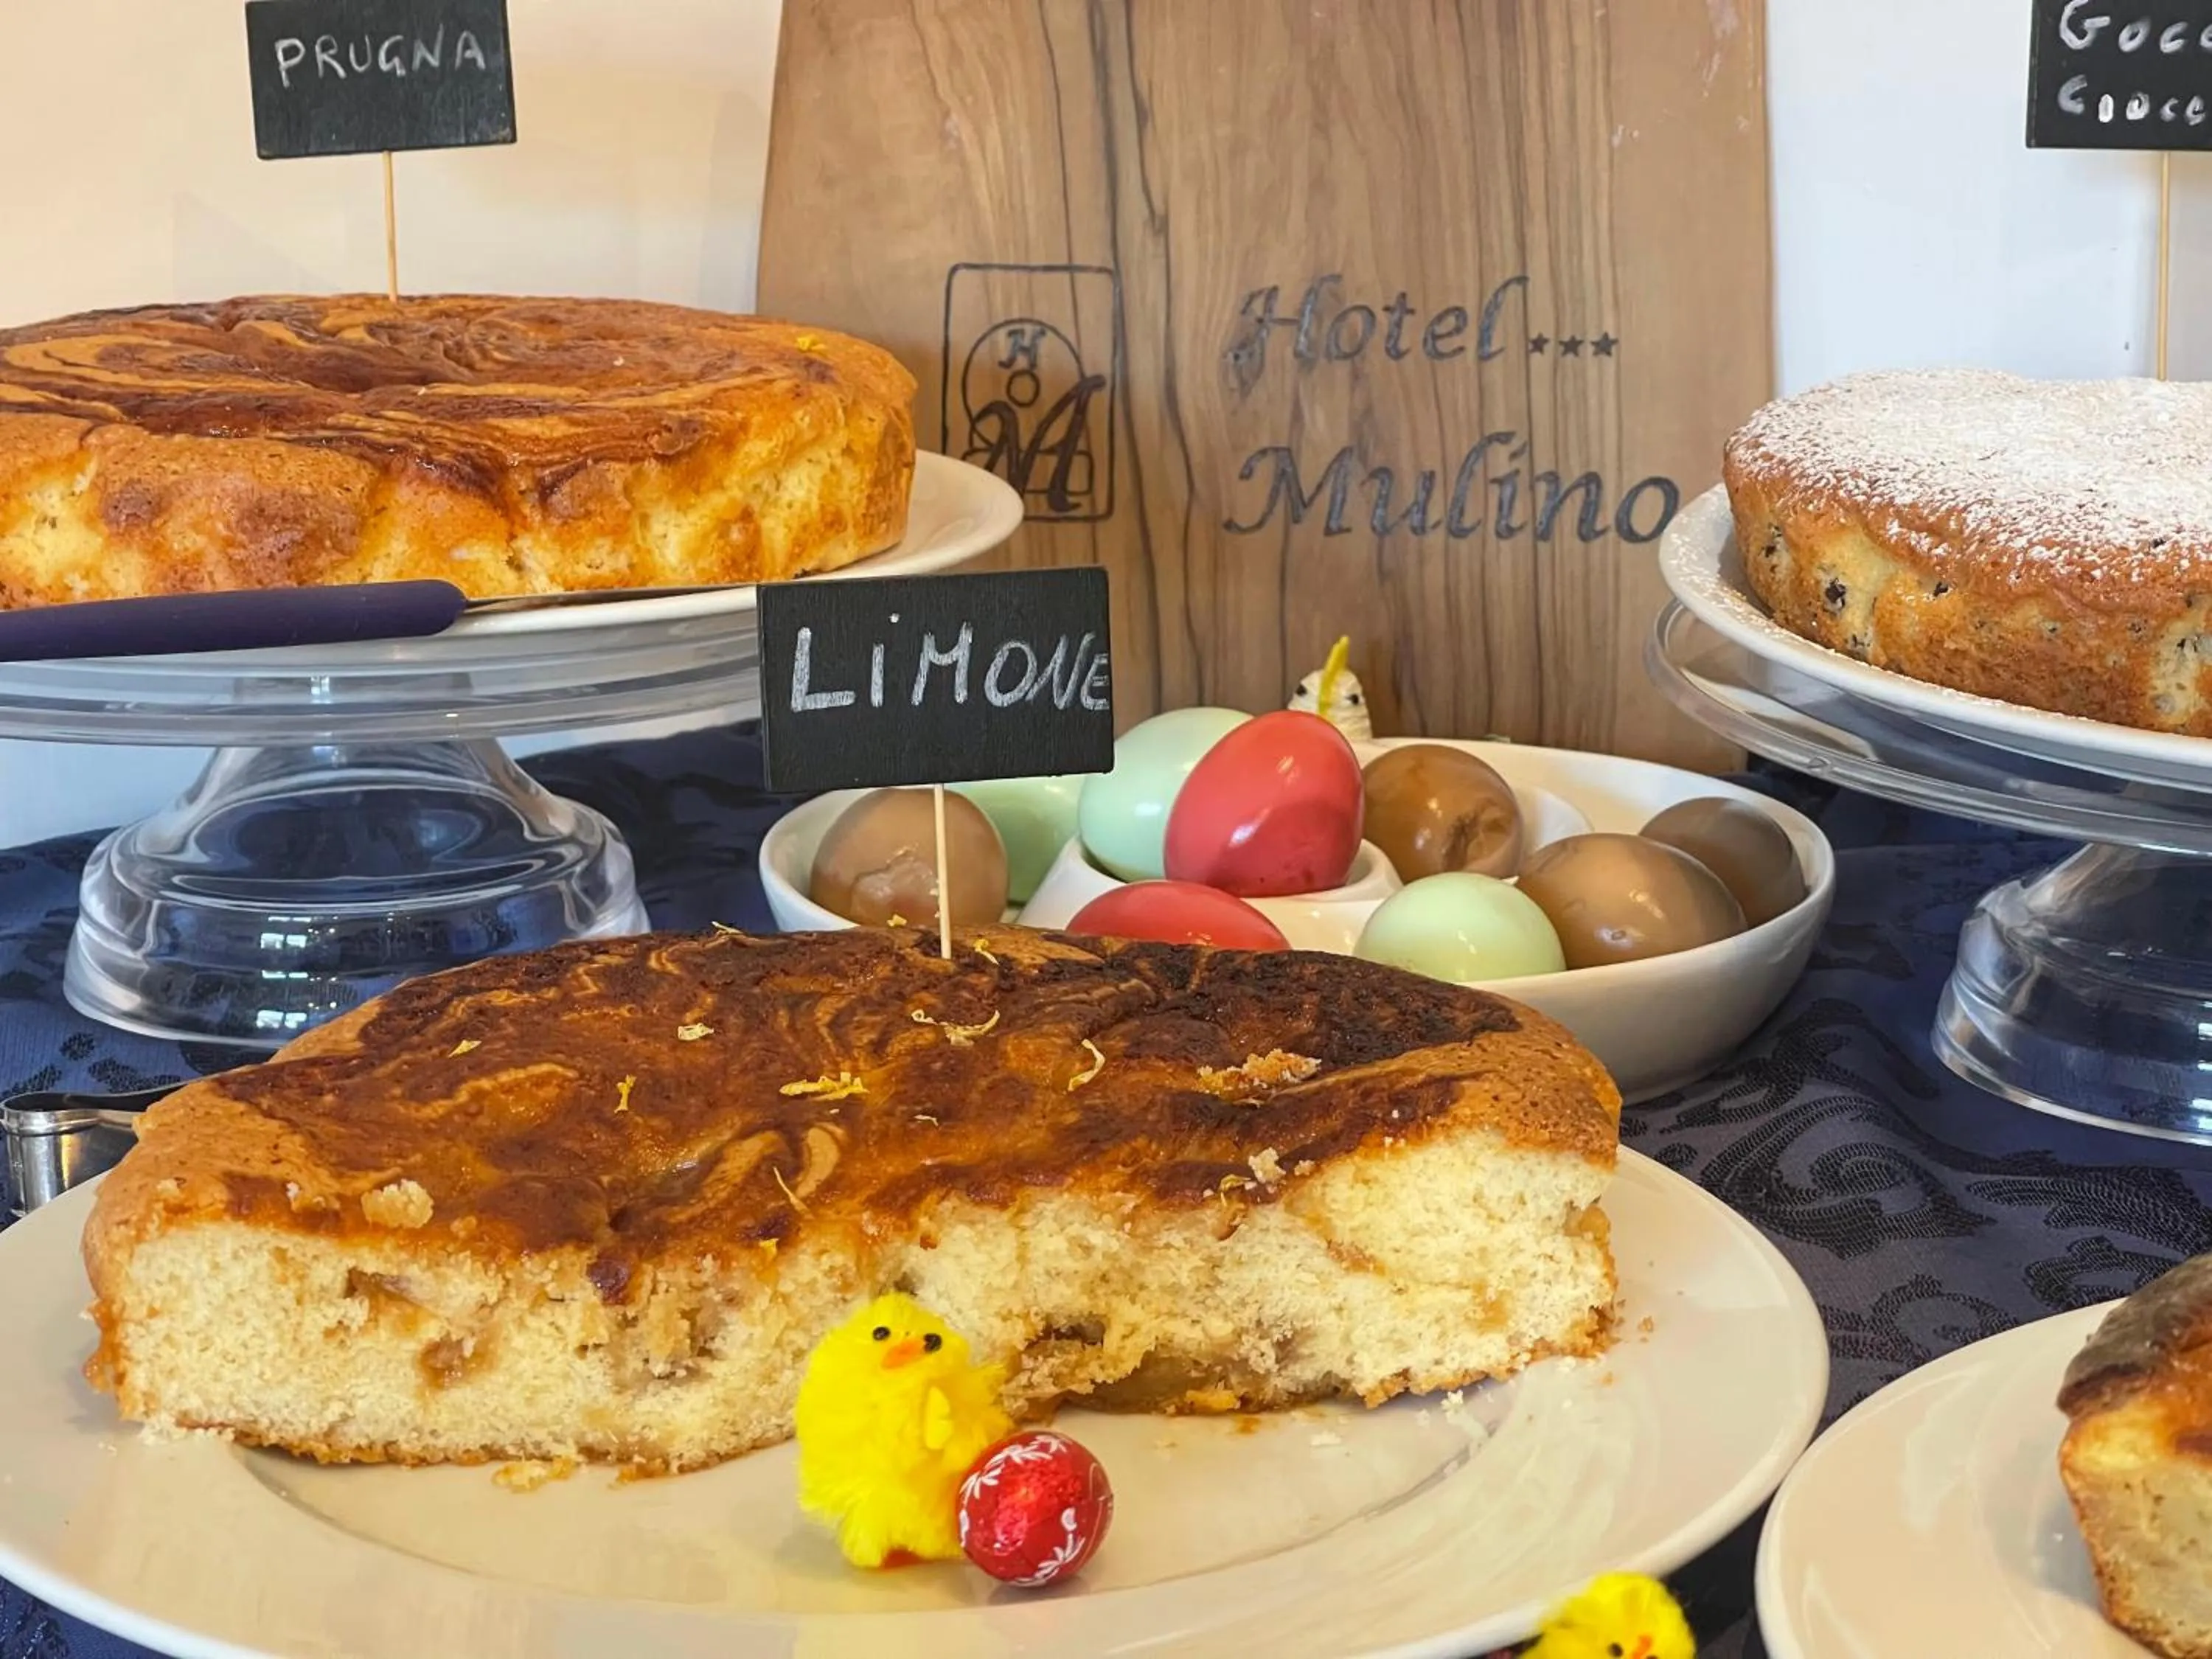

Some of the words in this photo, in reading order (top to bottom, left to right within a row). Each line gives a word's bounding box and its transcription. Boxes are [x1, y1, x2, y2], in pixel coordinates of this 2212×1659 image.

[274, 23, 486, 88] PRUGNA
[1222, 274, 1529, 394] Hotel
[1222, 431, 1680, 543] Mulino
